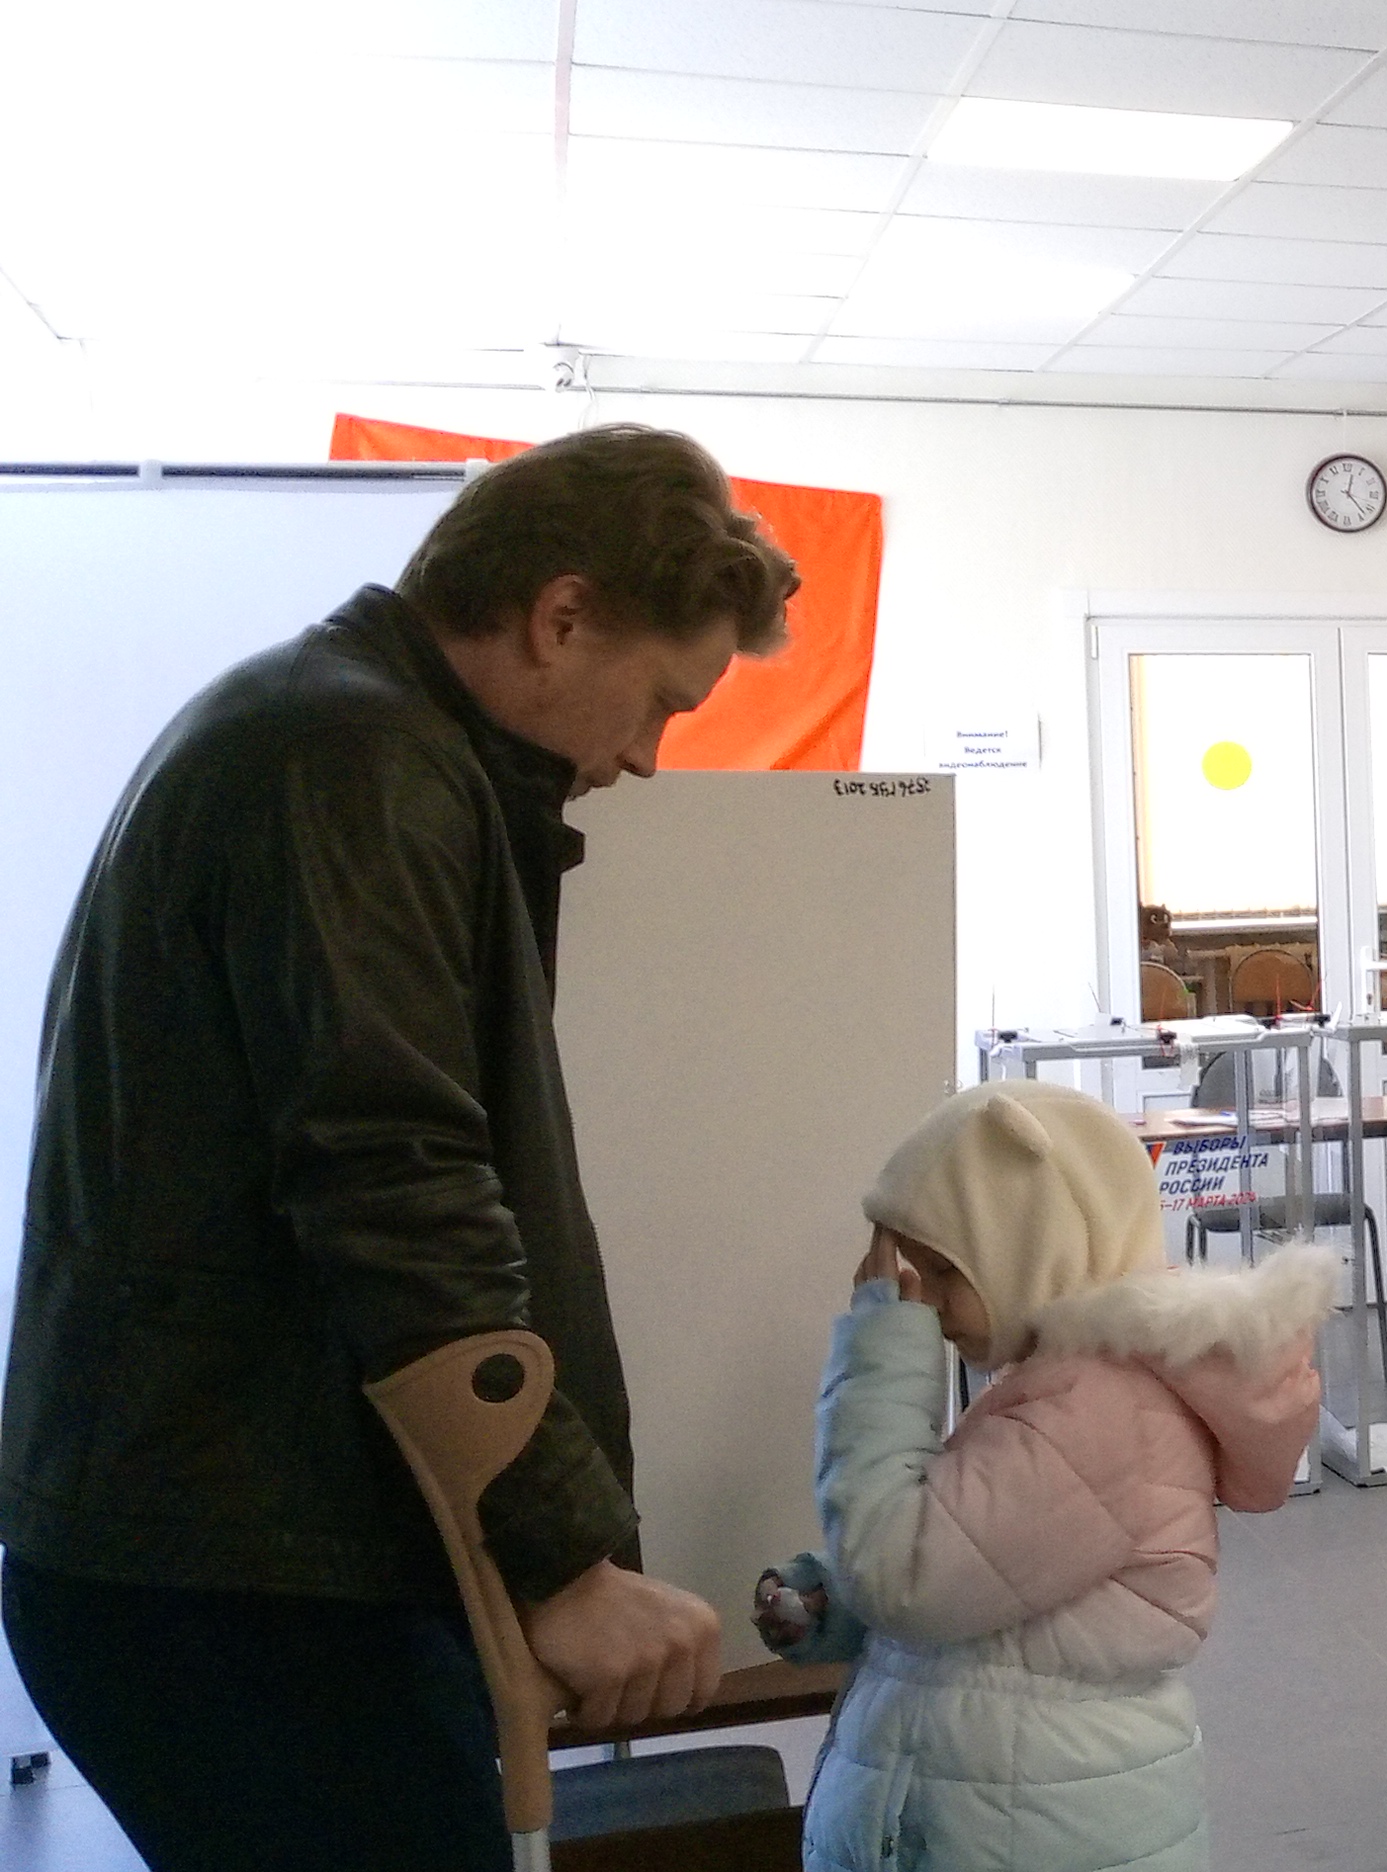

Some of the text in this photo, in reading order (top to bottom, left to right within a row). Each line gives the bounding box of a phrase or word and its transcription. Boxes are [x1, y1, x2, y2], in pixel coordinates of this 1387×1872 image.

[964, 746, 1002, 755] Ведется
[1173, 1135, 1247, 1156] ВЫБОРЫ
[1164, 1152, 1269, 1177] ПРЕЗИДЕНТА
[1159, 1175, 1226, 1195] РОССИИ
[1185, 1194, 1227, 1211] МАРТА
